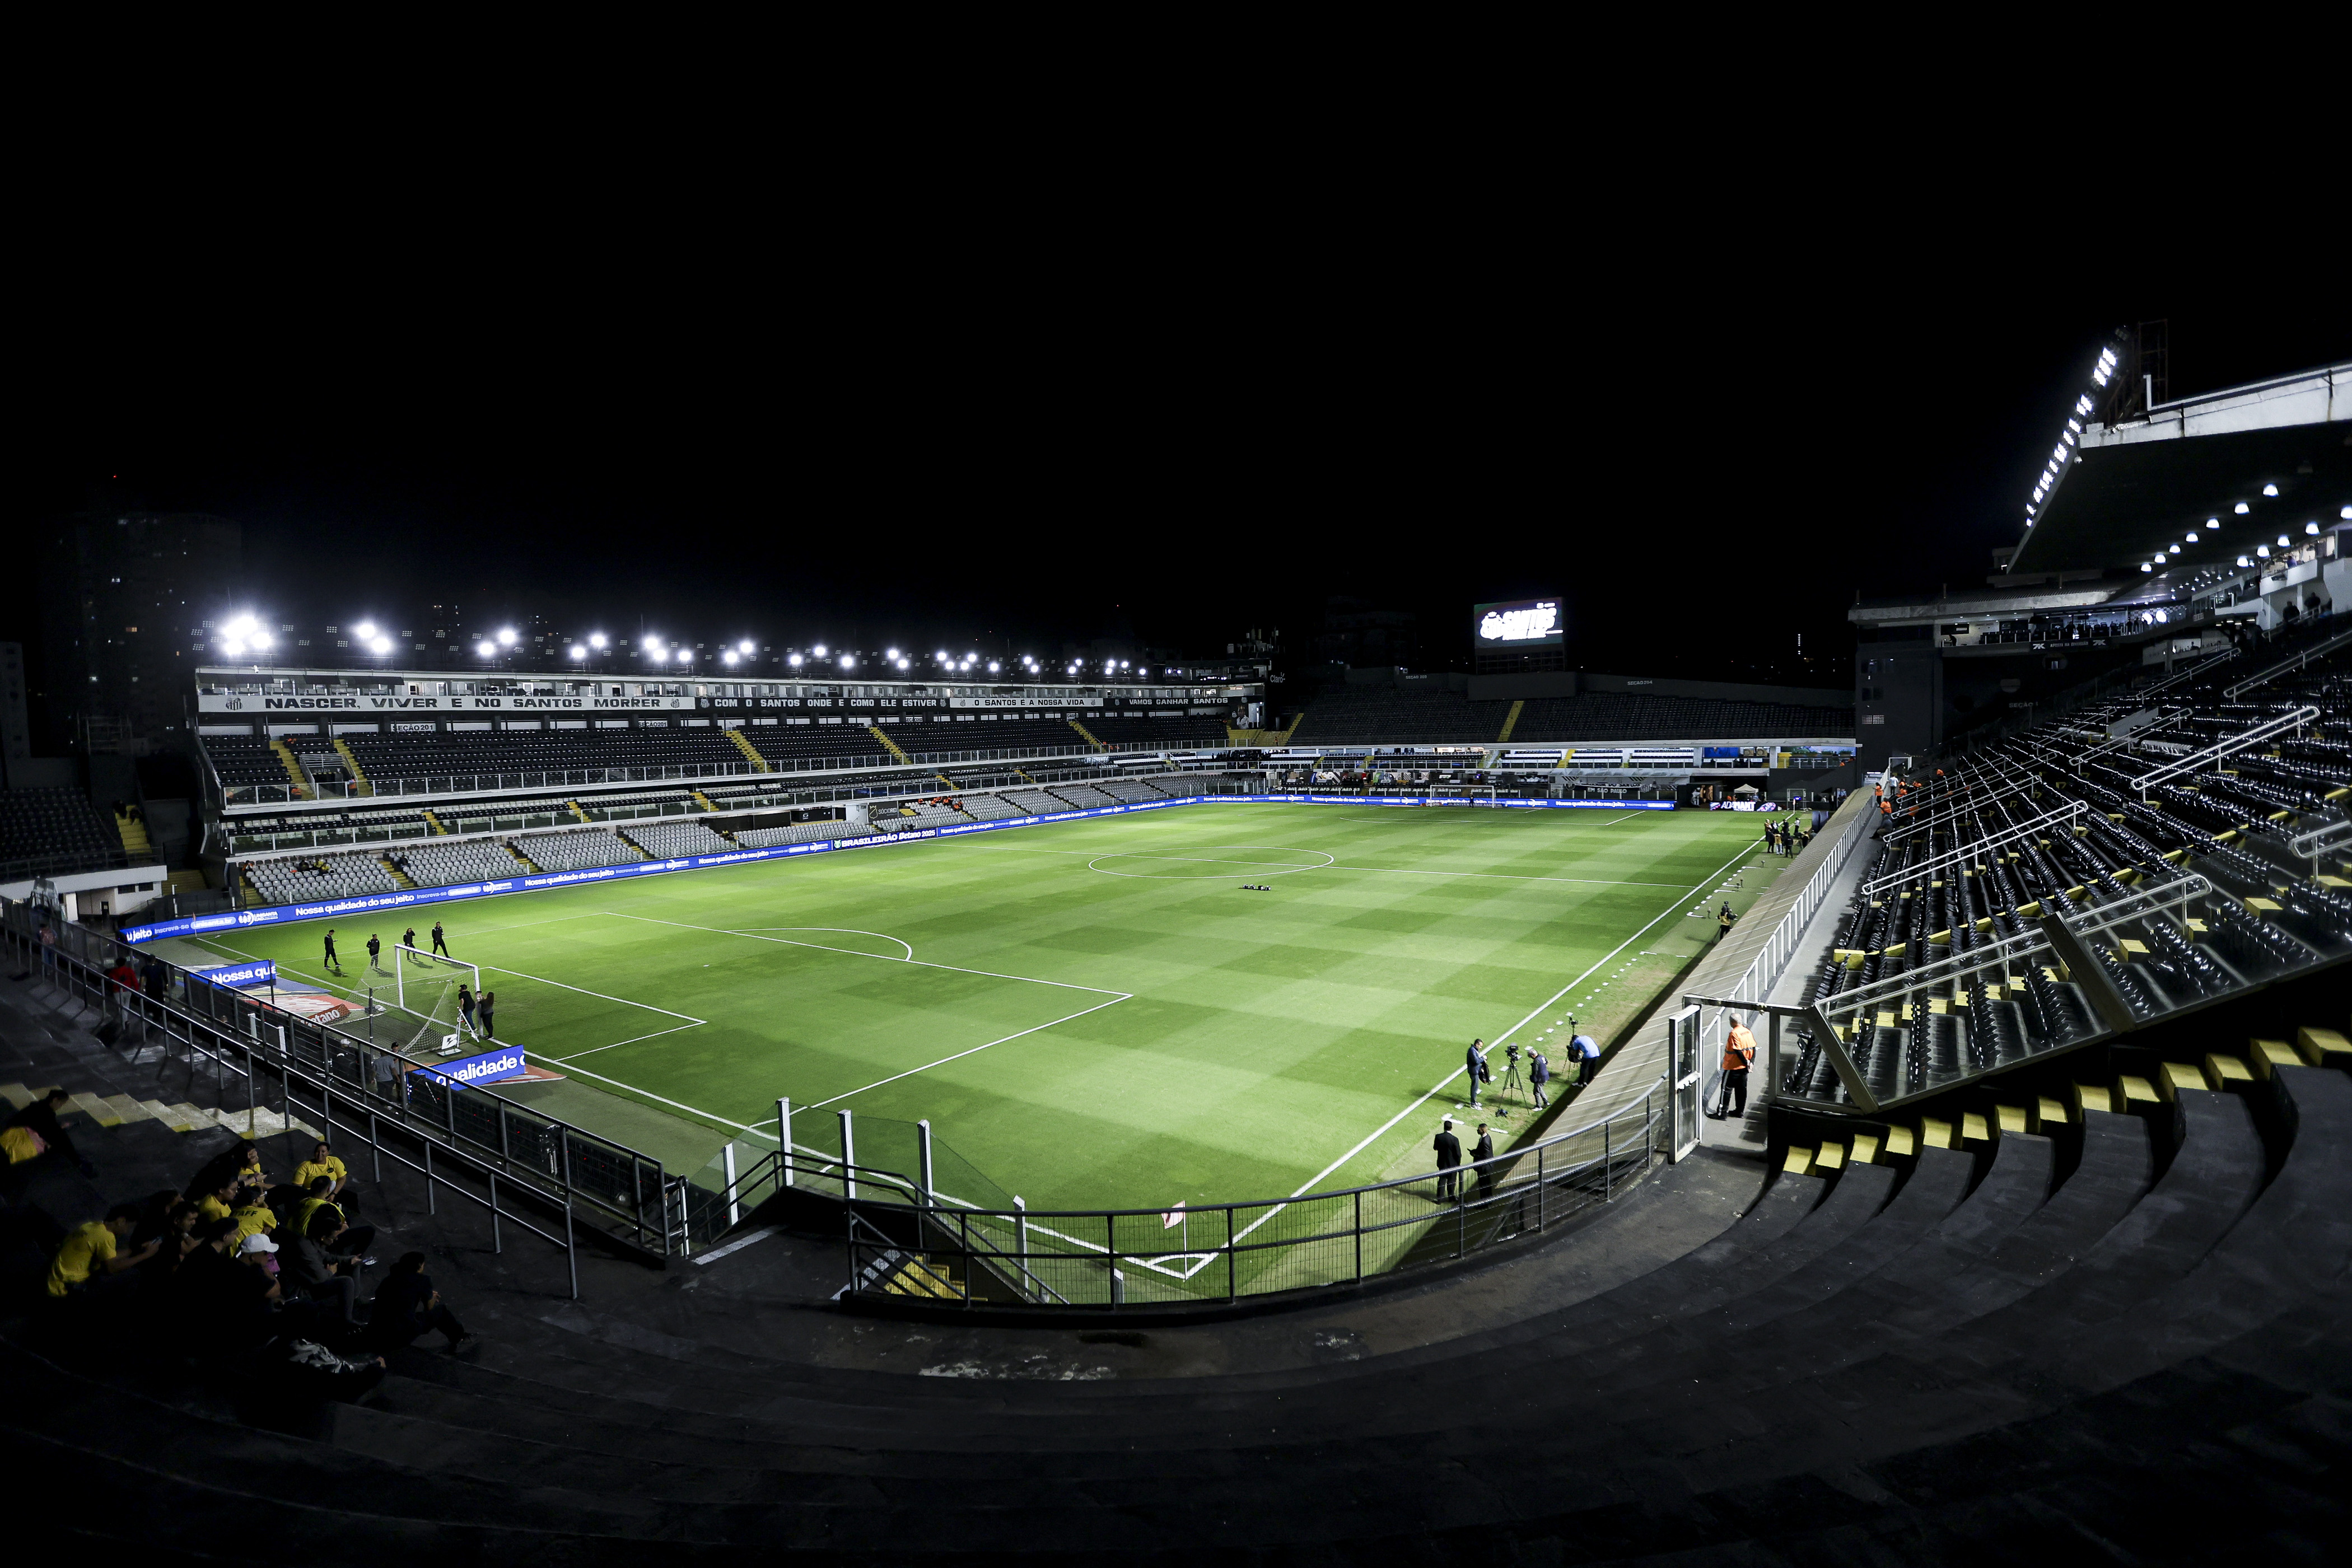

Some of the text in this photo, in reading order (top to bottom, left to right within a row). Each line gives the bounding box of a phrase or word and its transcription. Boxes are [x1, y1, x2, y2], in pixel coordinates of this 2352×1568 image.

[1270, 674, 1284, 683] Claro
[265, 698, 660, 710] NASCER, VIVER E NO SANTOS MORRER
[715, 699, 738, 707] COM
[745, 699, 753, 707] O
[760, 699, 800, 707] SANTOS
[807, 699, 832, 707] ONDE
[851, 699, 875, 707] COMO
[881, 699, 897, 707] ELE
[902, 699, 936, 707] ESTIVER
[1720, 801, 1756, 810] ADAMANT
[953, 825, 973, 833] qualidade
[841, 833, 898, 847] BRASILEIRÃO
[898, 831, 921, 840] Betano
[716, 854, 740, 865] qualidade
[757, 850, 769, 859] jeito
[525, 879, 547, 887] Nossa
[547, 874, 578, 885] qualidade
[599, 869, 615, 878] jeito
[296, 906, 324, 916] Nossa
[324, 901, 367, 914] qualidade
[367, 898, 379, 907] do
[380, 897, 394, 906] seu
[394, 894, 414, 904] jeito
[417, 891, 447, 899] Inscreva-se
[132, 928, 152, 942] jeito
[154, 924, 189, 934] Inscreva-se
[211, 969, 254, 984] Nossa
